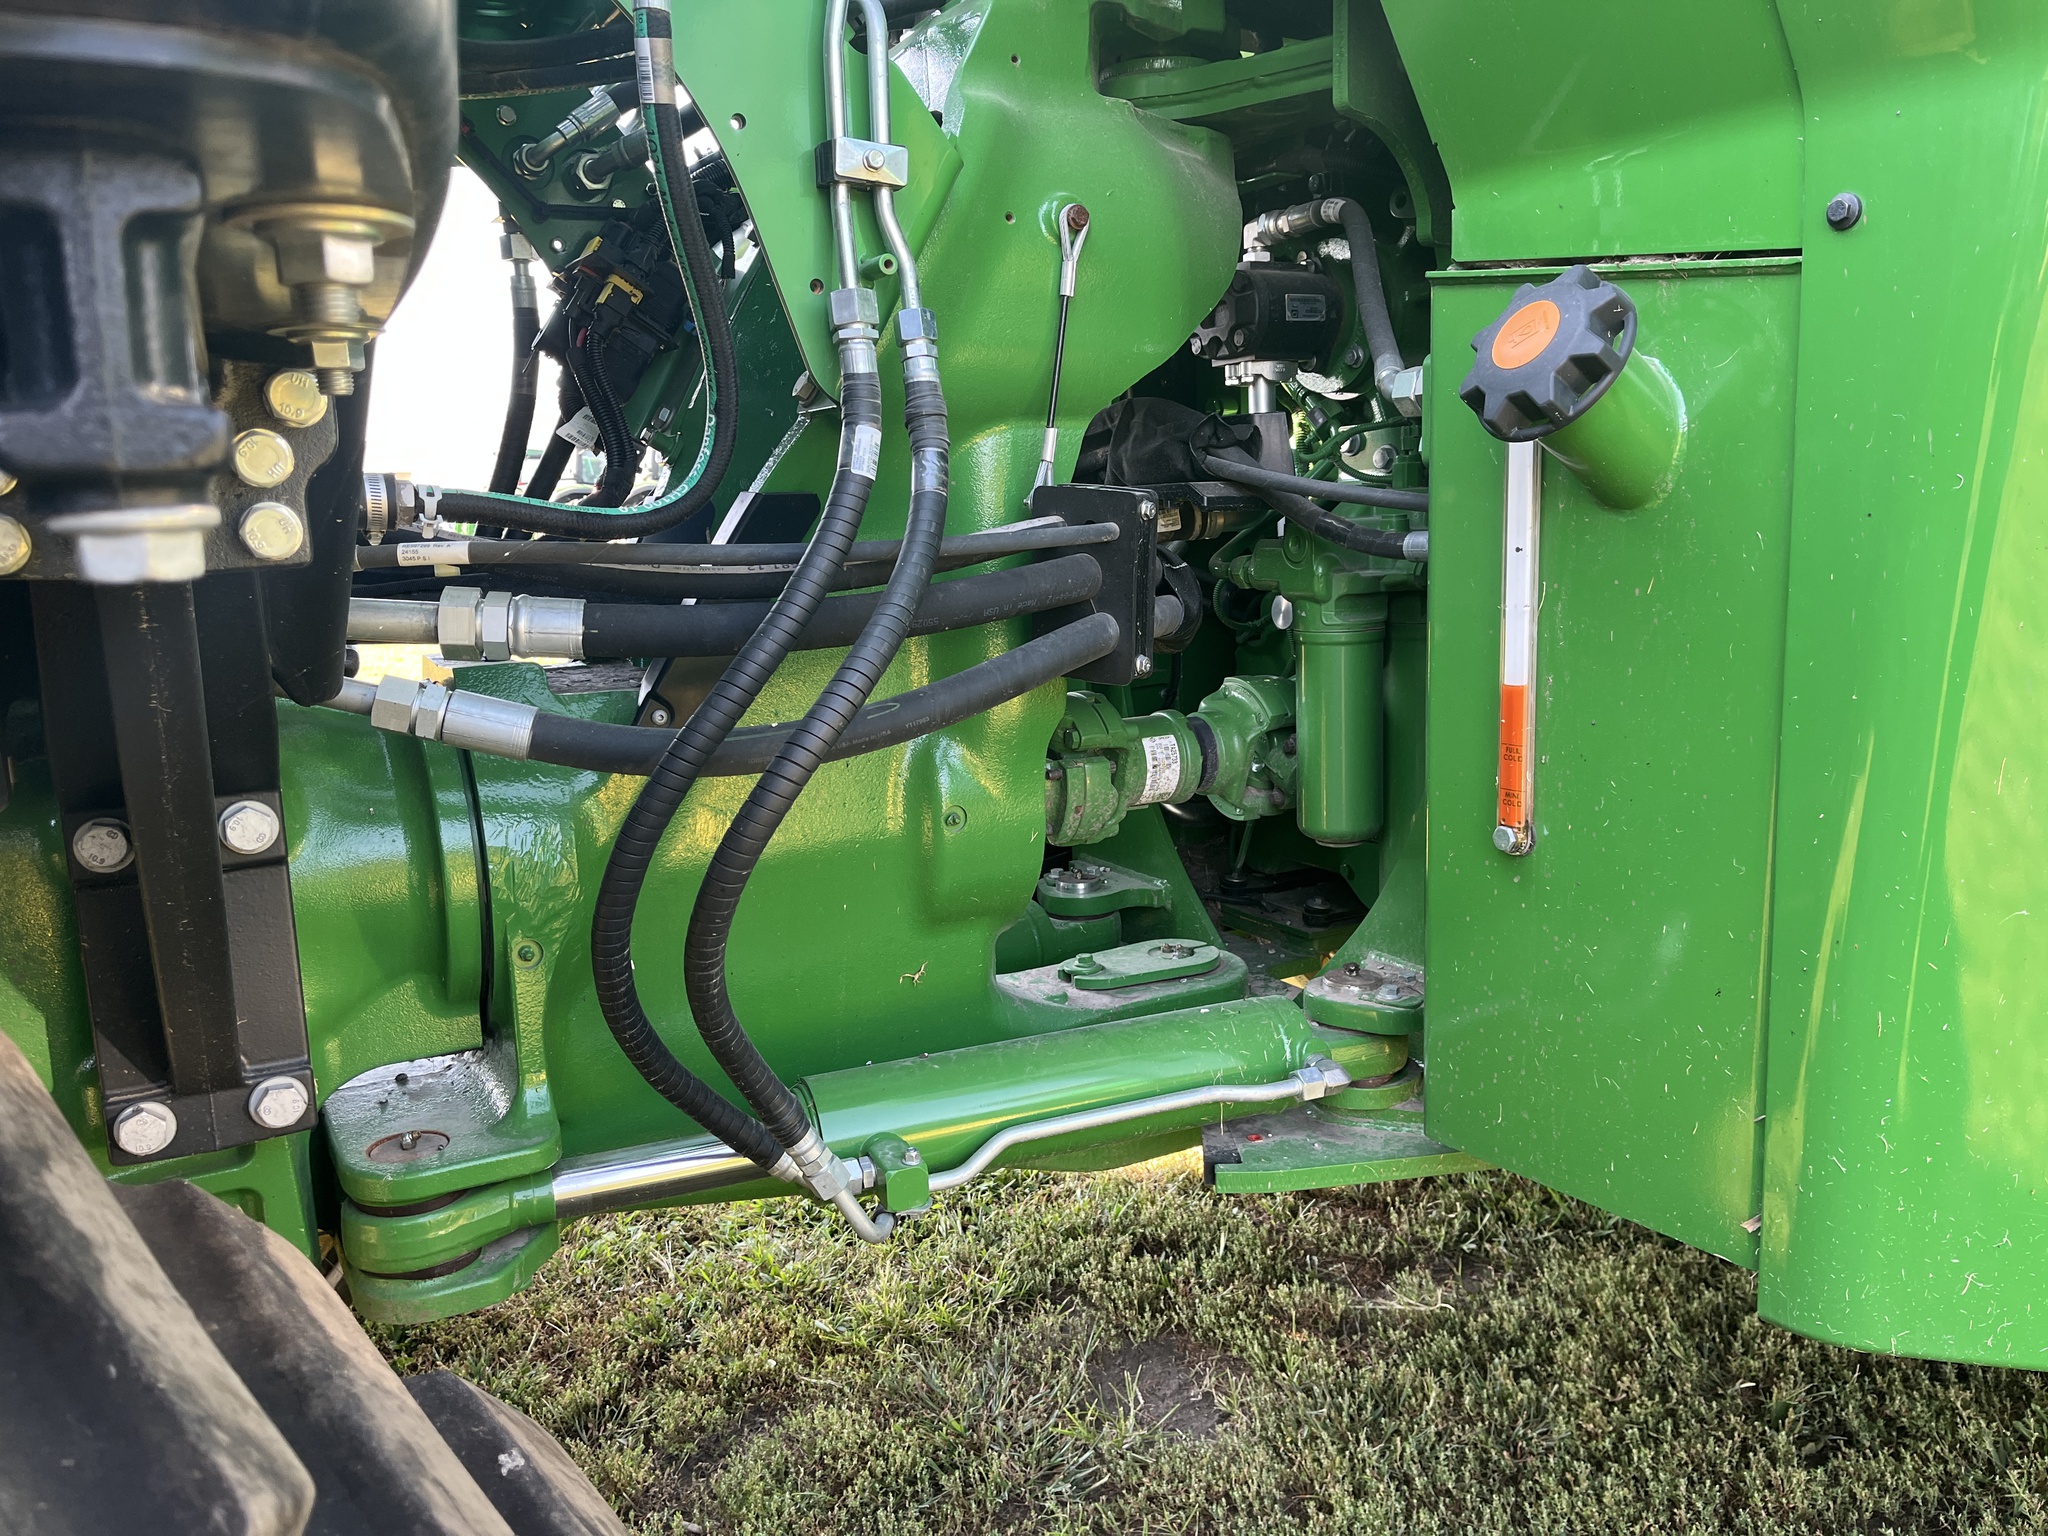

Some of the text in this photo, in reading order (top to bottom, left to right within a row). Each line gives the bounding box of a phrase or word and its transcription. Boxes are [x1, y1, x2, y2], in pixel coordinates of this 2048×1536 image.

[291, 374, 310, 388] UH
[279, 402, 305, 418] 10.9
[1017, 599, 1038, 609] Made
[983, 606, 1000, 617] USA
[1505, 746, 1521, 754] FULL
[1503, 754, 1523, 762] COLD
[1502, 799, 1522, 807] COLD
[89, 853, 106, 865] 10.9
[135, 1143, 152, 1152] 10.9
